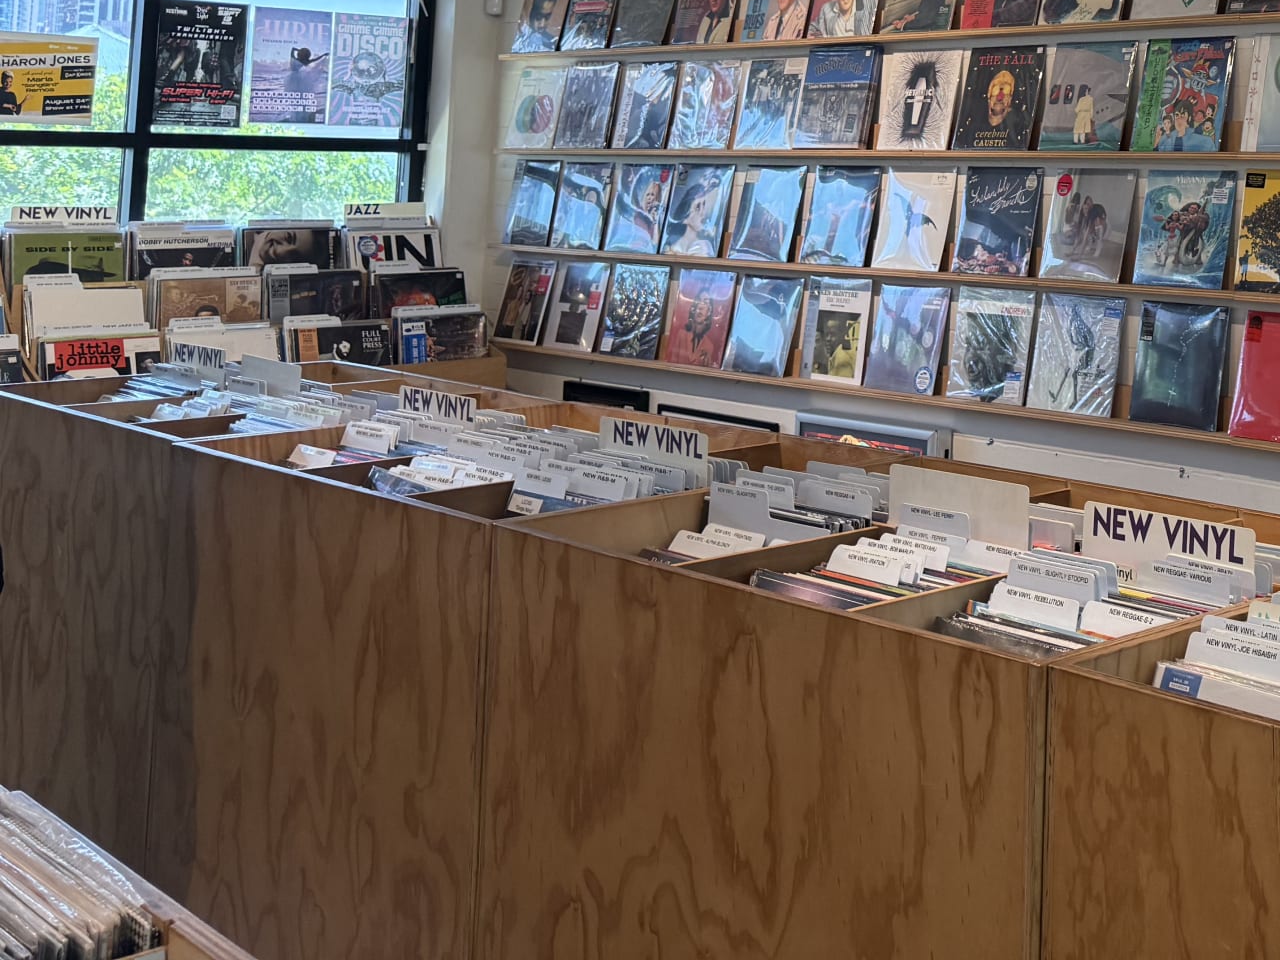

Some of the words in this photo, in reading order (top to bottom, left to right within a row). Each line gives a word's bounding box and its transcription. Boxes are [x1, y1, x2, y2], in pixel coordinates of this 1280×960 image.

[177, 25, 227, 35] TWILIGHT
[338, 23, 370, 34] GIMME
[373, 26, 404, 37] GIMME
[337, 33, 403, 60] DISCO
[0, 58, 46, 67] HARON
[50, 55, 91, 66] JONES
[979, 54, 1000, 66] THE
[1003, 53, 1035, 66] FALL
[162, 87, 204, 98] SUPER
[975, 129, 1009, 139] cerebral
[973, 139, 1007, 147] CAUSTIC
[19, 207, 61, 220] NEW
[64, 207, 112, 220] VINYL
[346, 204, 381, 215] JAZZ
[25, 245, 57, 253] SIDE
[61, 245, 80, 253] BY
[83, 245, 114, 253] SIDE
[361, 329, 381, 337] FULL
[68, 341, 121, 357] little
[56, 352, 122, 371] johnny
[174, 342, 198, 363] NEW
[197, 345, 224, 369] VINYL
[403, 388, 433, 413] NEW
[435, 392, 474, 423] VINYL
[613, 420, 649, 448] NEW
[654, 425, 703, 460] VINYL
[464, 471, 477, 479] NEW
[475, 466, 488, 474] NEW
[654, 466, 672, 475] R&B-T
[582, 471, 597, 480] NEW
[597, 474, 616, 483] R&B-M
[941, 512, 955, 520] PERRY
[931, 534, 947, 542] PEPPER
[1092, 505, 1154, 545] NEW
[1162, 516, 1244, 566] VINYL
[1017, 563, 1028, 571] NEW
[1028, 565, 1042, 575] VINYL
[1044, 569, 1067, 581] SLIGHTLY
[1067, 574, 1090, 585] STOOPID
[1153, 565, 1166, 574] NEW
[1188, 572, 1213, 584] VARIOUS
[1006, 588, 1018, 596] NEW
[1018, 591, 1031, 600] VINYL
[1033, 594, 1065, 608] REBELUTION
[1109, 608, 1122, 617] NEW
[1225, 623, 1240, 633] NEW
[1239, 626, 1256, 637] VINYL
[1260, 630, 1278, 641] LATIN
[1205, 637, 1221, 647] NEW
[1250, 647, 1278, 661] HISAISHI
